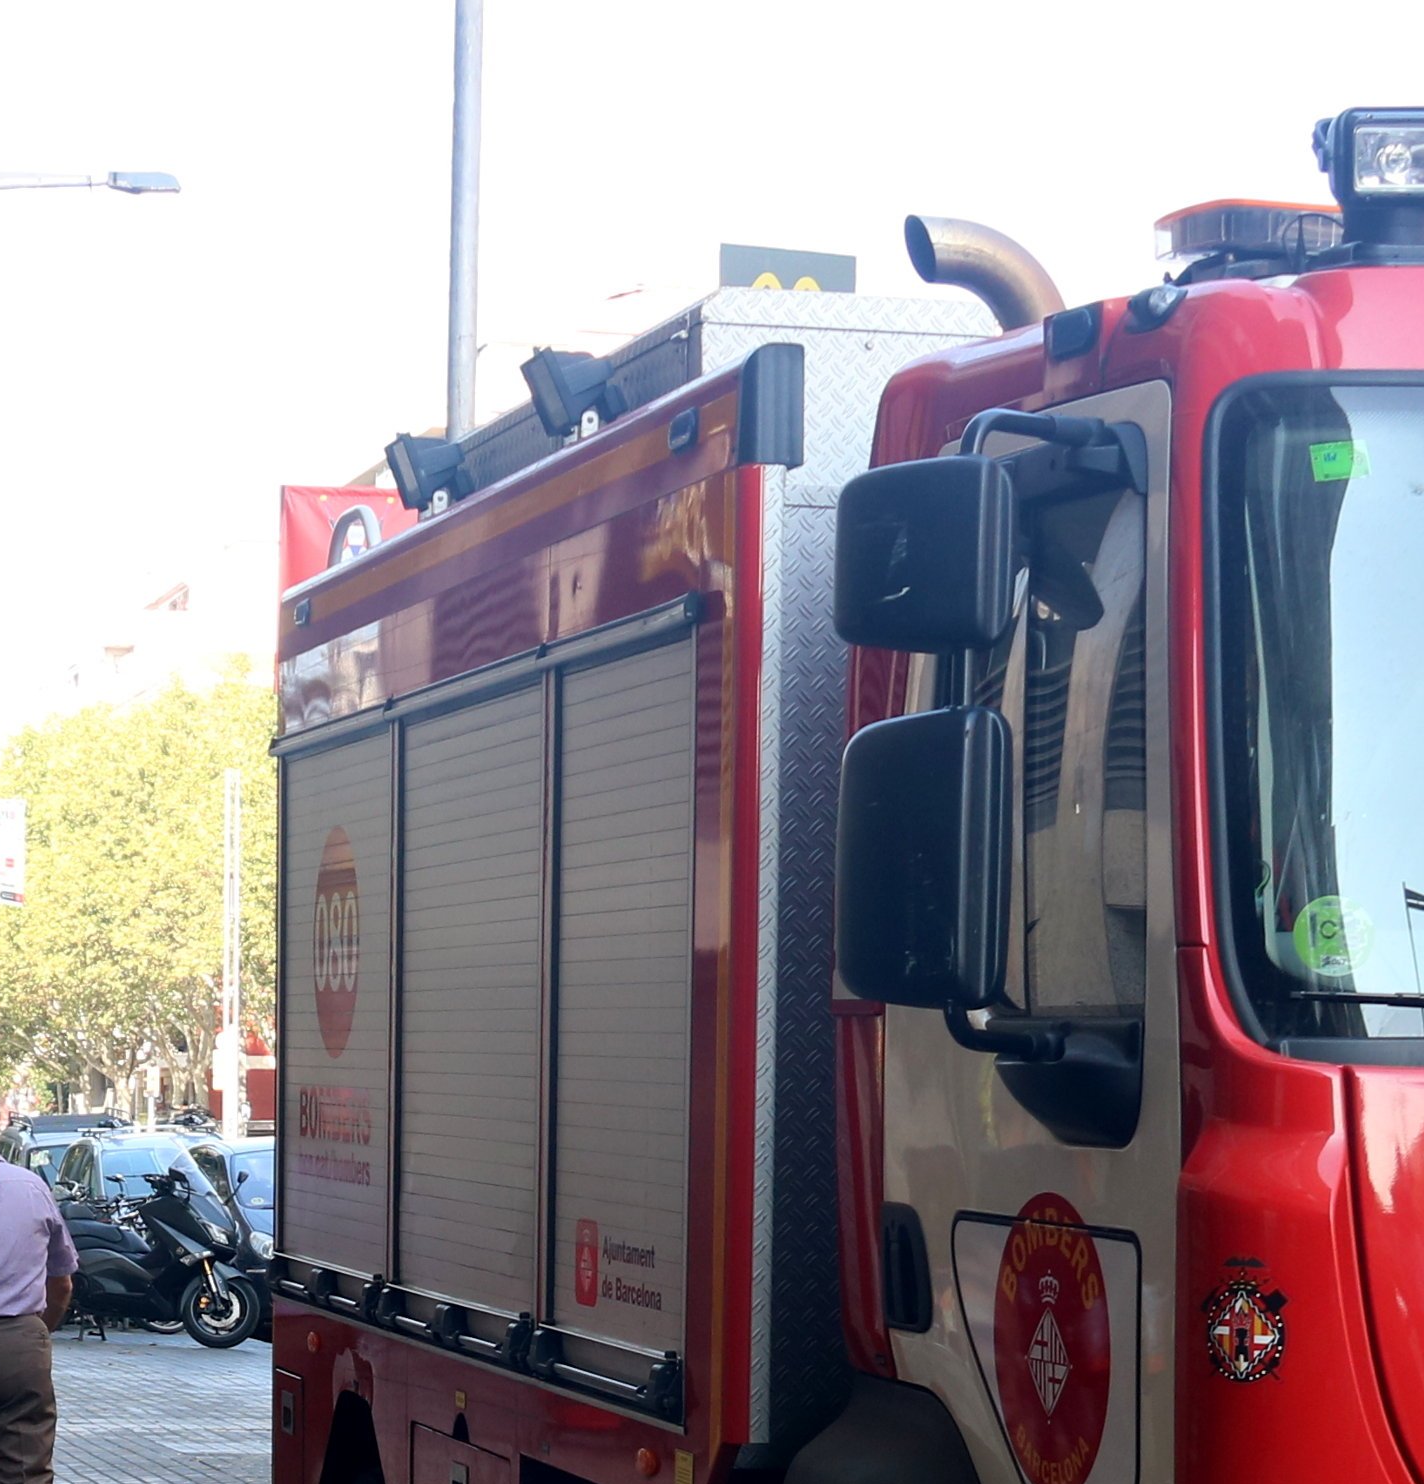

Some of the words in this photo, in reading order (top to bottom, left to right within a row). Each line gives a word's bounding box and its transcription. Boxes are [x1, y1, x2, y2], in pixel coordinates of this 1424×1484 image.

[315, 892, 358, 993] 080
[299, 1086, 371, 1145] BOMBERS
[602, 1235, 655, 1269] Ajuntament
[1002, 1207, 1099, 1310] BOMBERS
[601, 1275, 613, 1299] de
[615, 1277, 662, 1311] Barcelona
